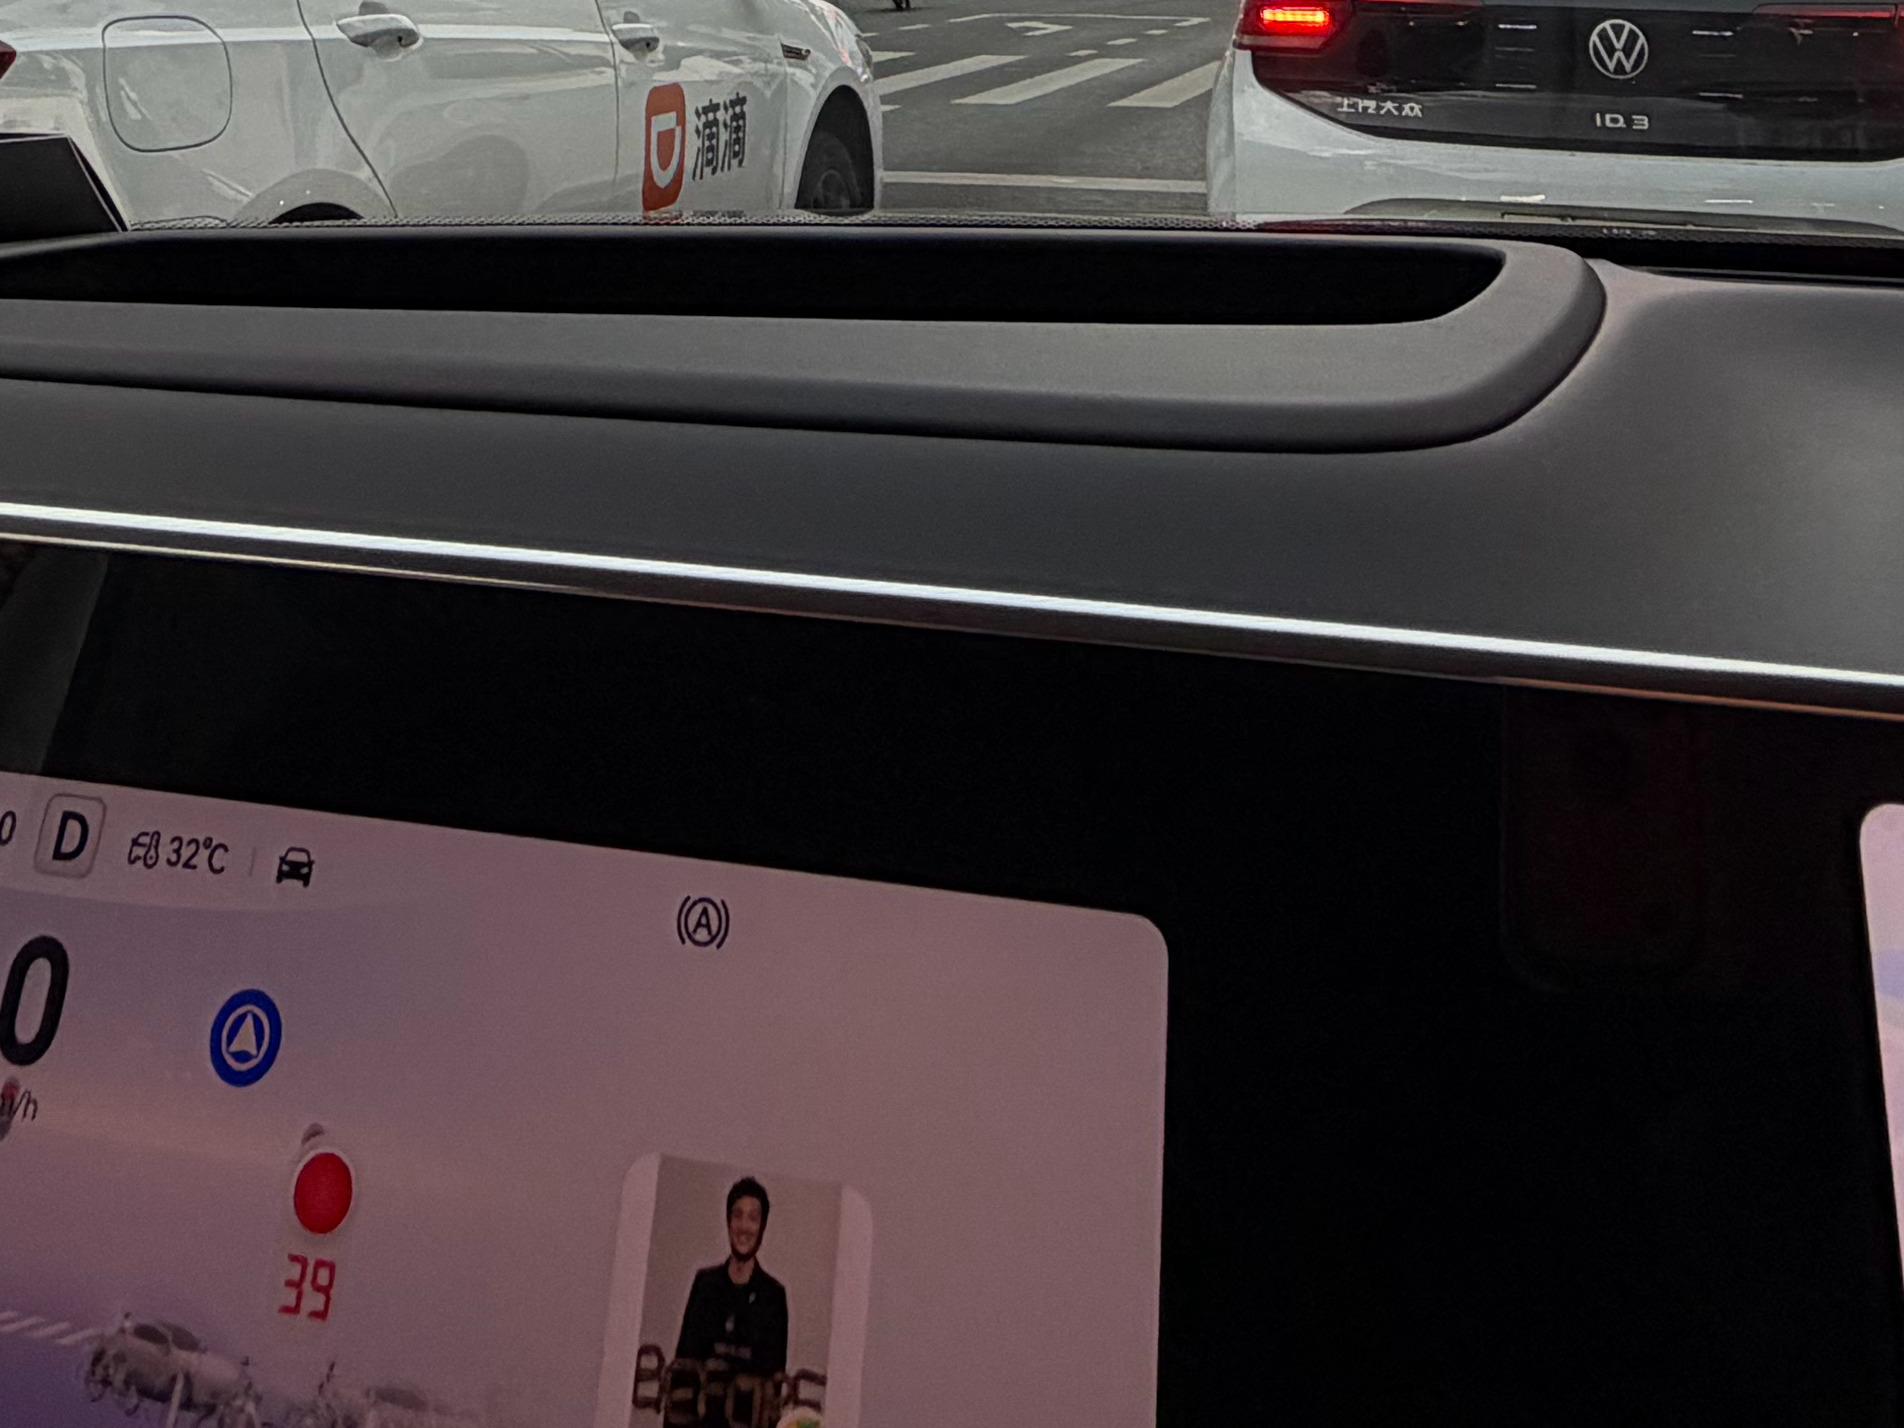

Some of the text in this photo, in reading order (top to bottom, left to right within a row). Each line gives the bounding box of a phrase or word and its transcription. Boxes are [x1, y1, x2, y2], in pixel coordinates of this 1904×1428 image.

[692, 91, 747, 181] 滴滴
[1337, 97, 1423, 118] 上汽大众
[52, 810, 90, 862] D
[277, 1253, 336, 1322] 39
